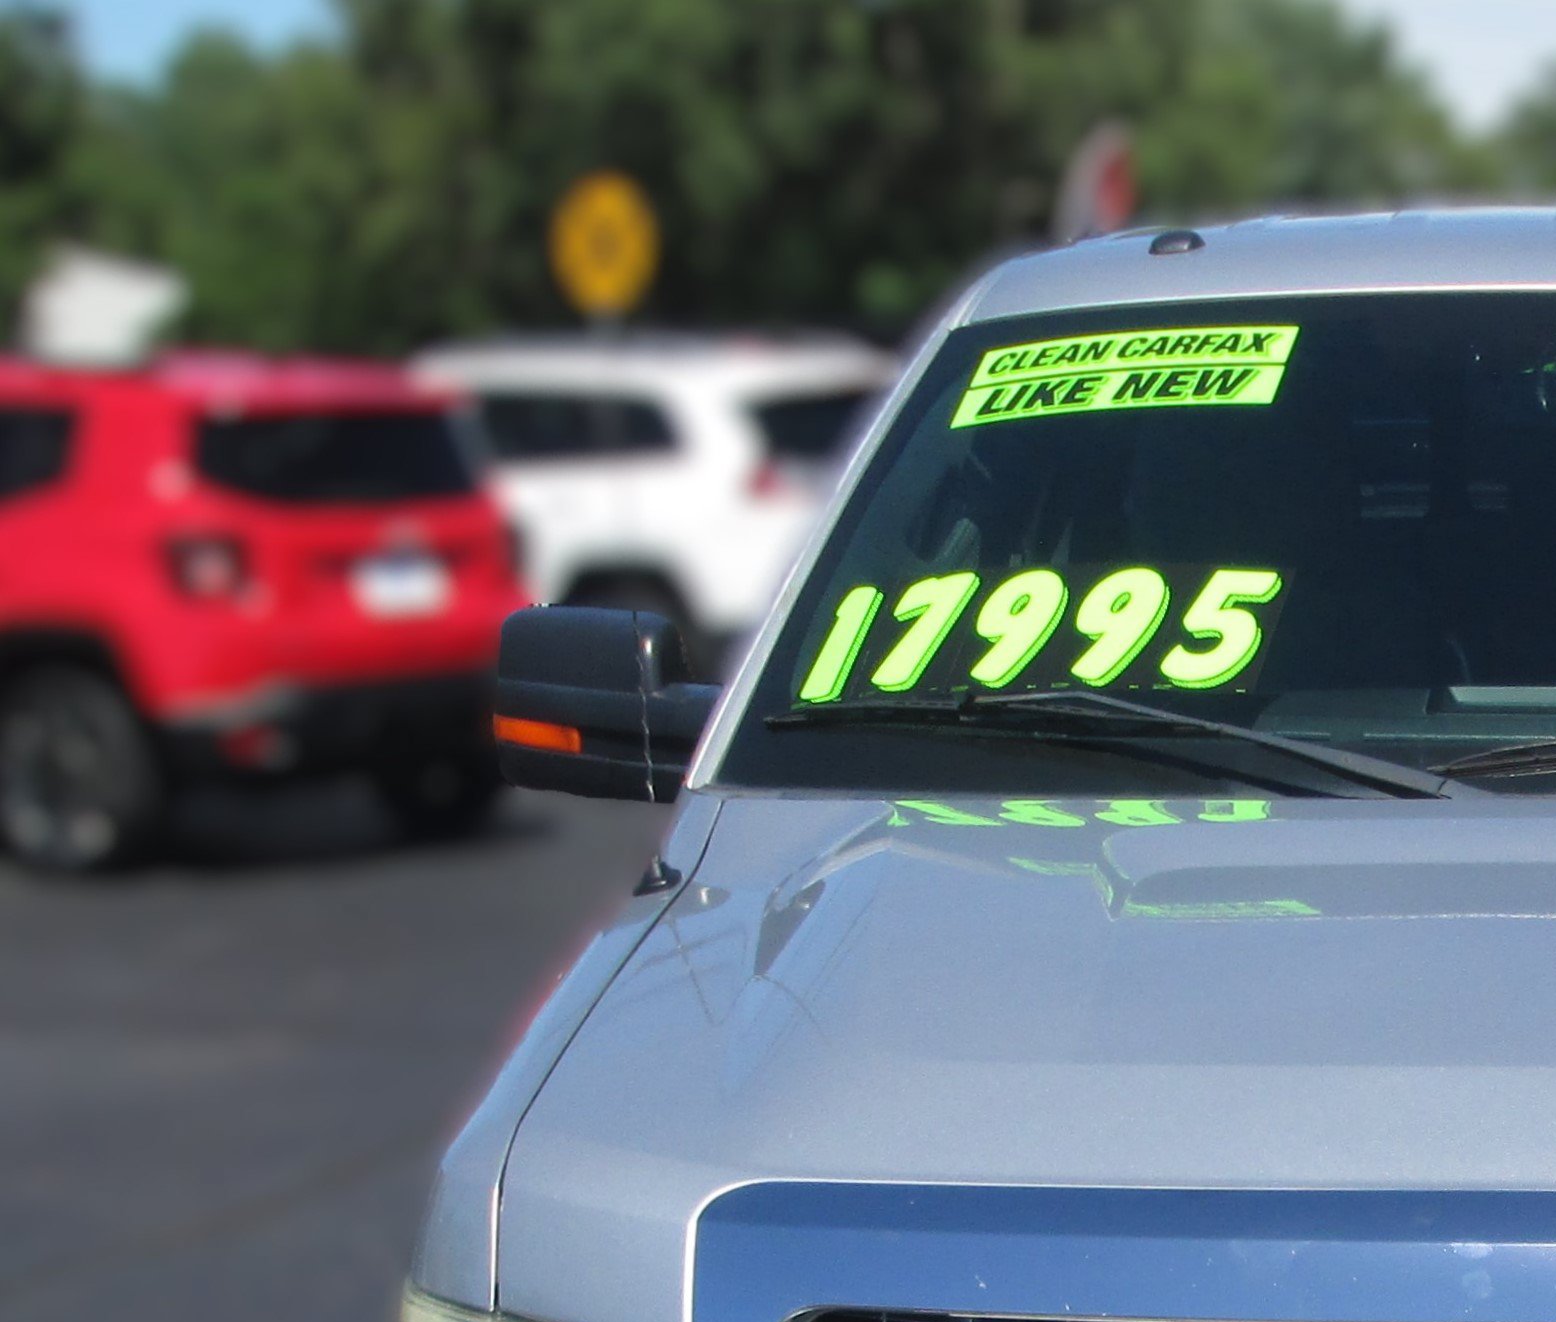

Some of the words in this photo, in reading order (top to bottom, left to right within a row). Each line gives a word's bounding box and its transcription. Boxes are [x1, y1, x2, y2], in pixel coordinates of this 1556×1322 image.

[987, 339, 1114, 375] CLEAN
[1117, 331, 1278, 360] CARFAX
[975, 375, 1107, 417] LIKE
[1110, 368, 1258, 402] NEW
[801, 568, 1282, 703] 17995
